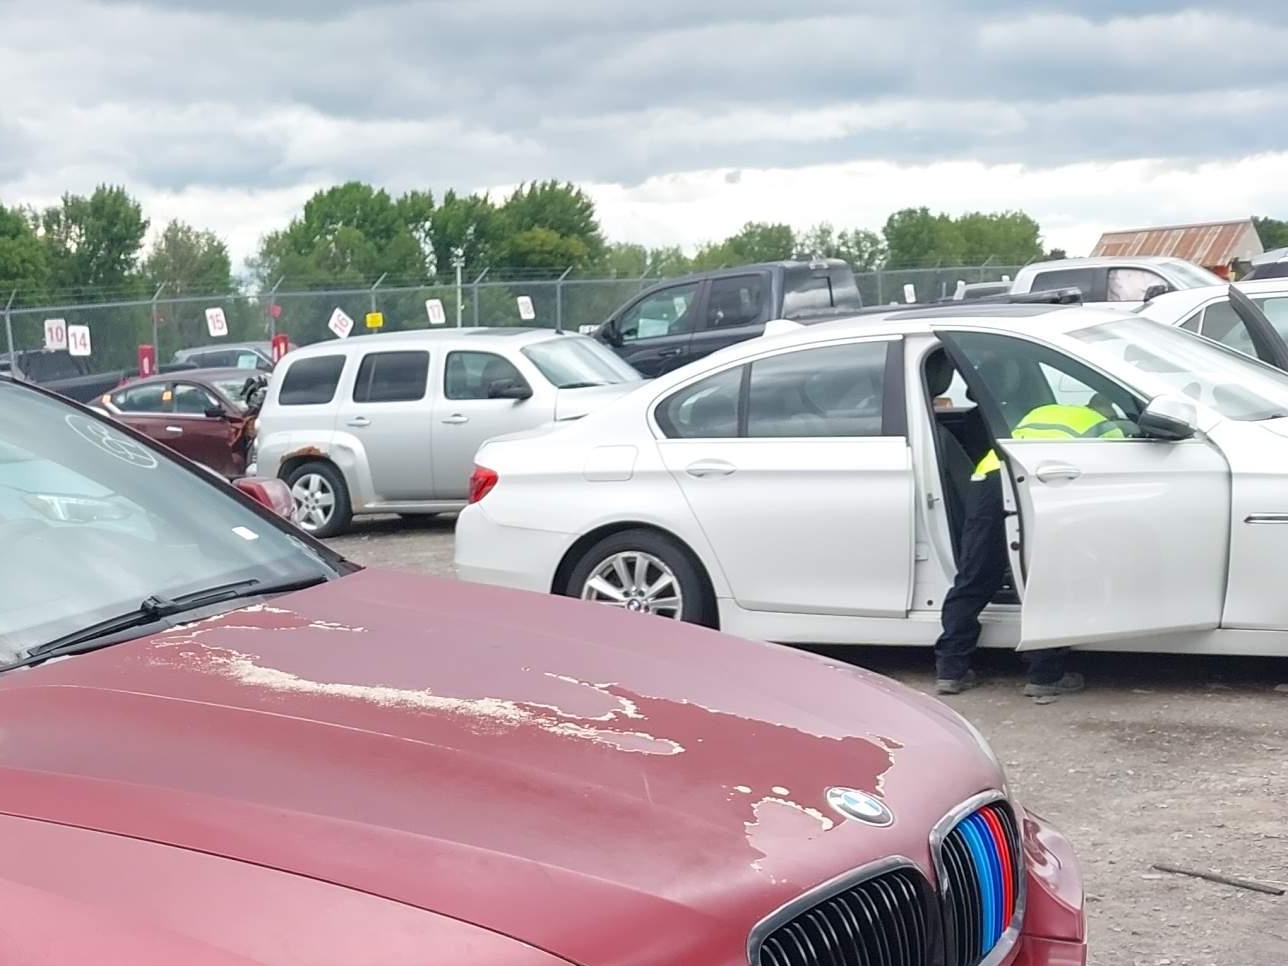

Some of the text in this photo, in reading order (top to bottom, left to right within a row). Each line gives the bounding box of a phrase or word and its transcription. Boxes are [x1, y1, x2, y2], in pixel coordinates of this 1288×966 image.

[208, 313, 225, 331] 15
[47, 326, 64, 342] 10
[70, 332, 88, 350] 14
